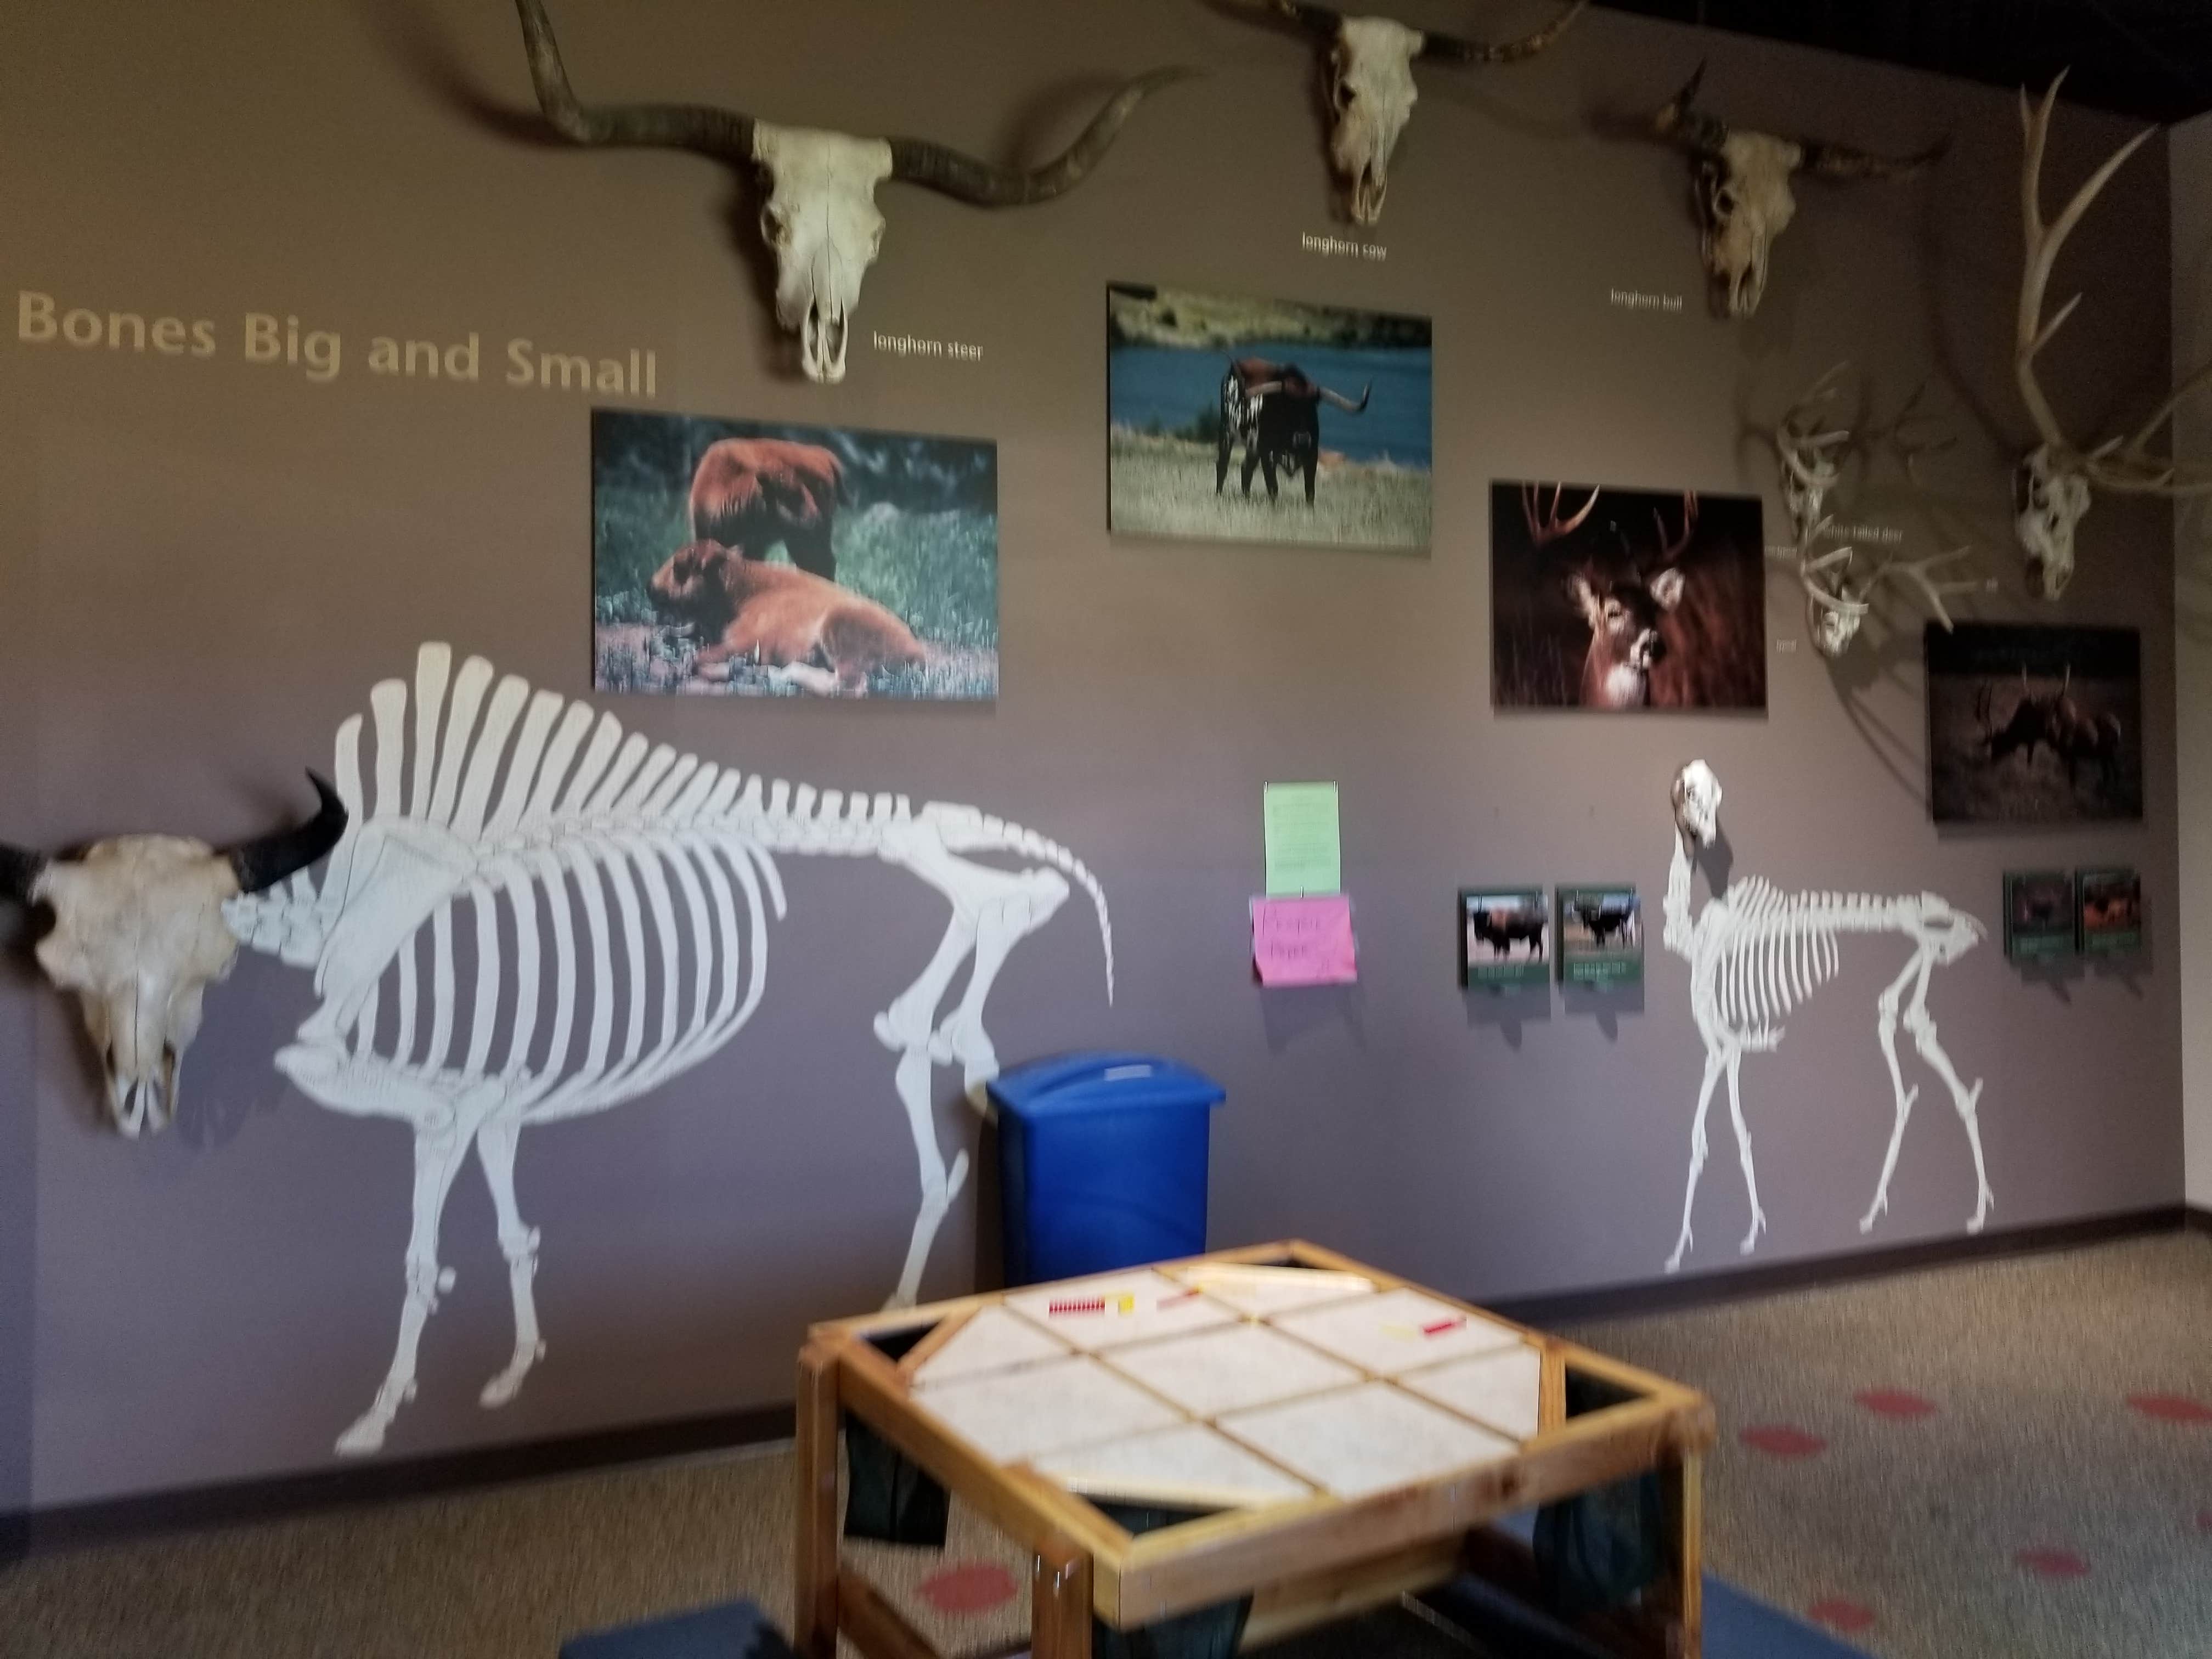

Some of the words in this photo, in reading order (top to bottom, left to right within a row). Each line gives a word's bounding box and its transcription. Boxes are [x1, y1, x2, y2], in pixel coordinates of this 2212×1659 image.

[1302, 230, 1359, 258] longhorn
[1362, 242, 1387, 261] cow
[1611, 287, 1660, 309] longhorn
[1663, 293, 1682, 312] bull
[18, 289, 217, 359] Bones
[244, 311, 341, 383] Big
[368, 331, 480, 382] and
[506, 336, 657, 400] Small
[873, 329, 942, 358] longhorn
[947, 340, 984, 362] steer
